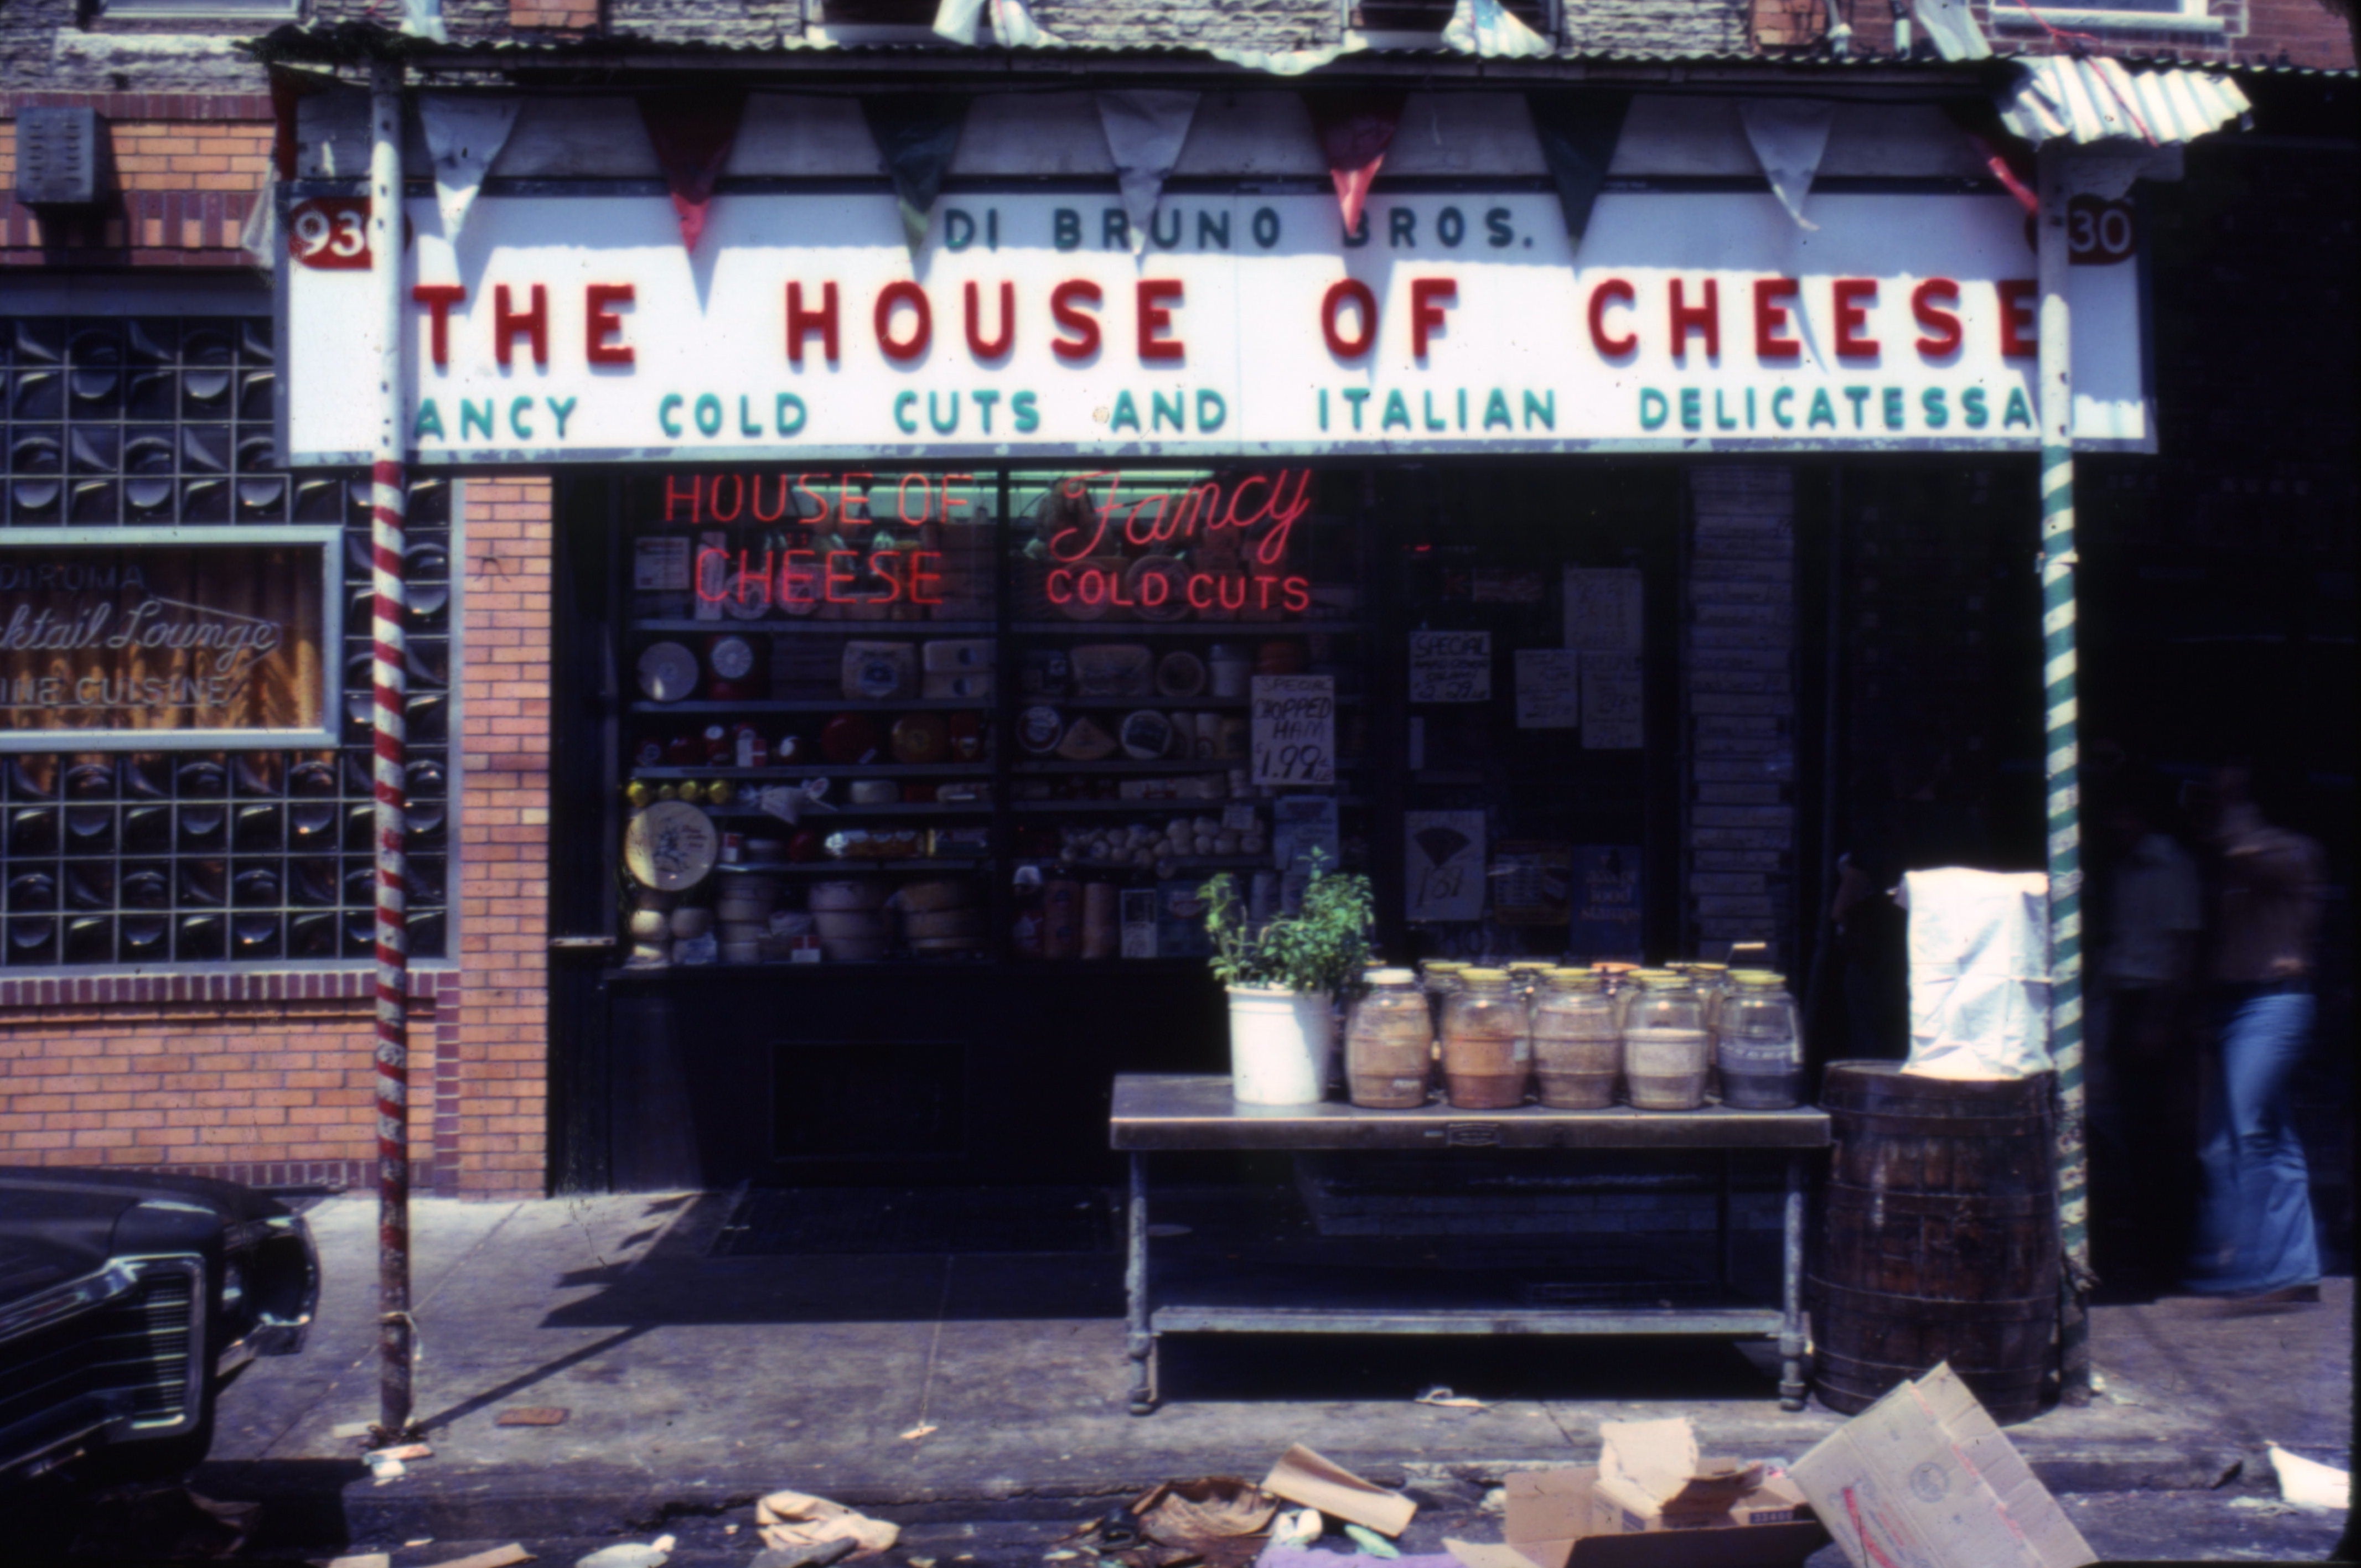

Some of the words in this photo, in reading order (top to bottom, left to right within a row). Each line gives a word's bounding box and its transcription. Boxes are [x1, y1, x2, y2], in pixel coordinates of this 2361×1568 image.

[295, 209, 374, 257] 93
[944, 209, 997, 252] DI
[1054, 206, 1281, 250] BRUNO
[1343, 206, 1534, 248] BROS.
[2069, 208, 2131, 254] 30
[413, 283, 635, 365] THE
[786, 279, 1185, 362] HOUSE
[1322, 278, 1458, 359] OF
[1588, 278, 2038, 357] CHEESE
[413, 396, 577, 441] ANCY
[659, 391, 807, 437] COLD
[894, 390, 1040, 434] CUTS
[1110, 388, 1226, 434] AND
[1318, 387, 1555, 432] ITALIAN
[1640, 386, 2032, 430] DELICATESSA
[666, 472, 873, 525] HOUSE
[898, 472, 974, 526] OF
[1050, 469, 1311, 563] Fancy
[695, 548, 943, 604] CHEESE
[1047, 569, 1169, 606] COLD
[1187, 573, 1311, 611] CUTS
[0, 603, 111, 650] ktail
[107, 599, 277, 671] Lounge
[76, 676, 227, 705] CUISINE
[1272, 720, 1324, 741] HAM
